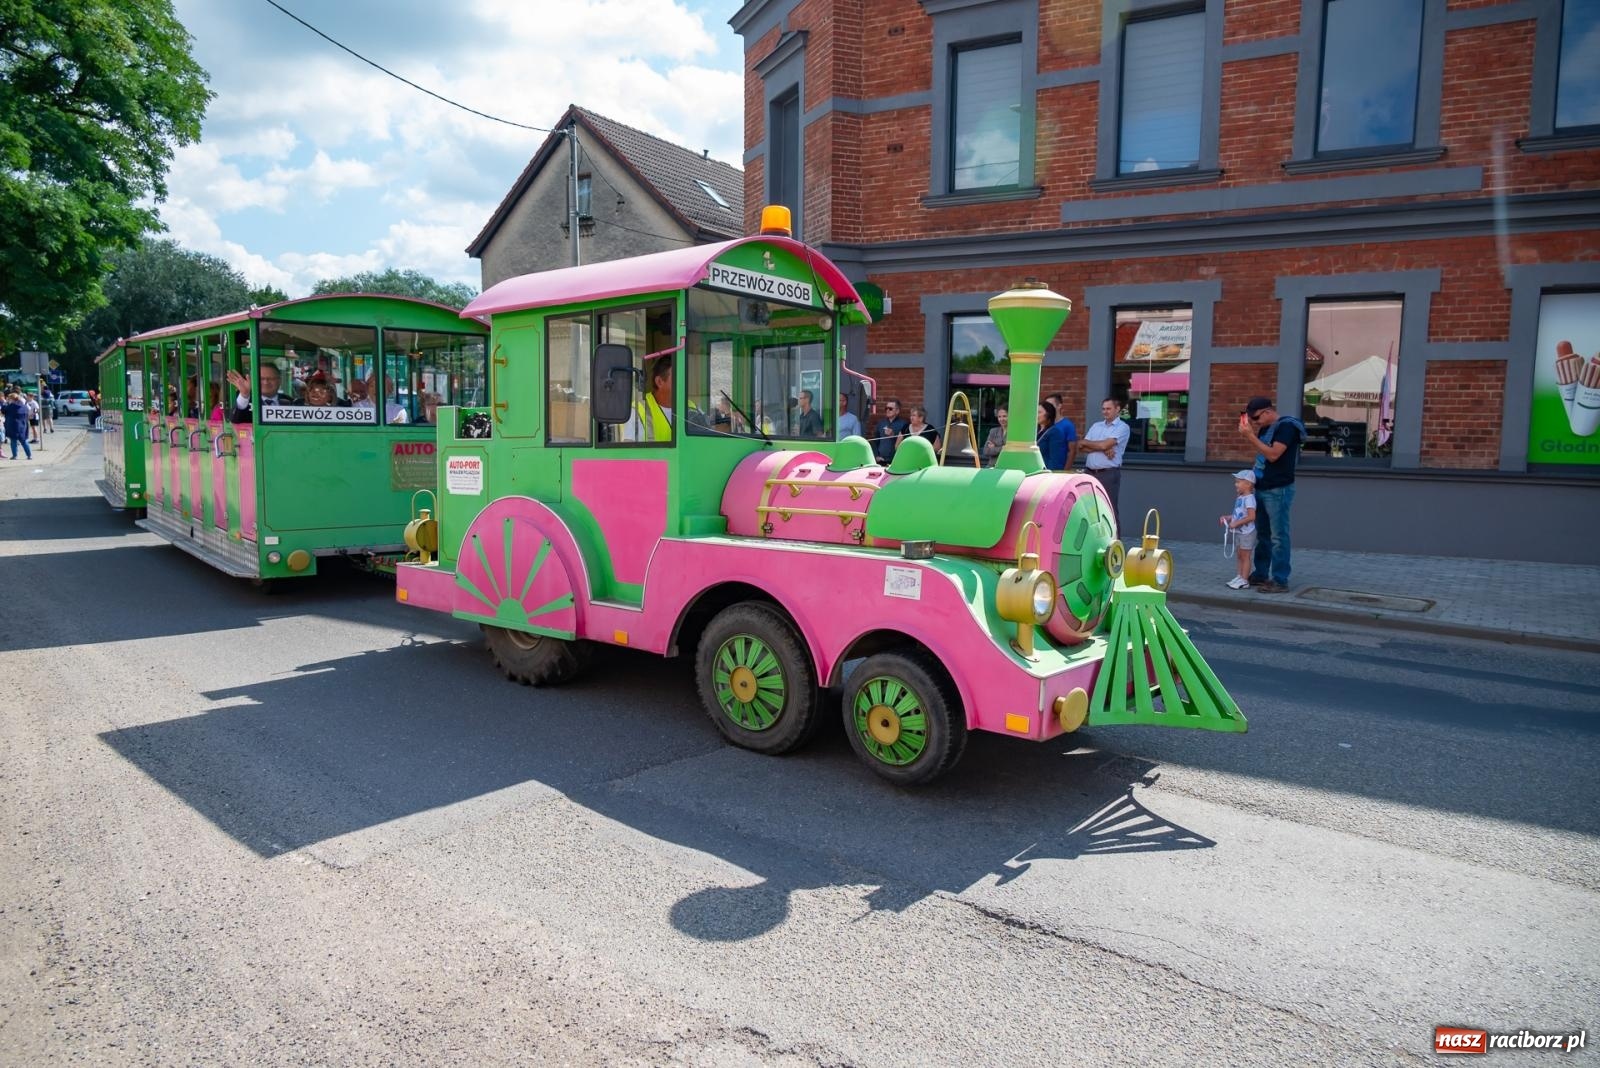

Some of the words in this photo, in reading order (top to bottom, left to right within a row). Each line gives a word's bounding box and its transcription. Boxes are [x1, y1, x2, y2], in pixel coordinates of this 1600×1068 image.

[712, 267, 775, 293] PRZEWÓZ
[777, 282, 810, 301] OSÓB
[265, 408, 332, 419] PRZEWÓZ
[336, 409, 372, 420] OSÓB
[449, 461, 480, 469] AUTO-PORT
